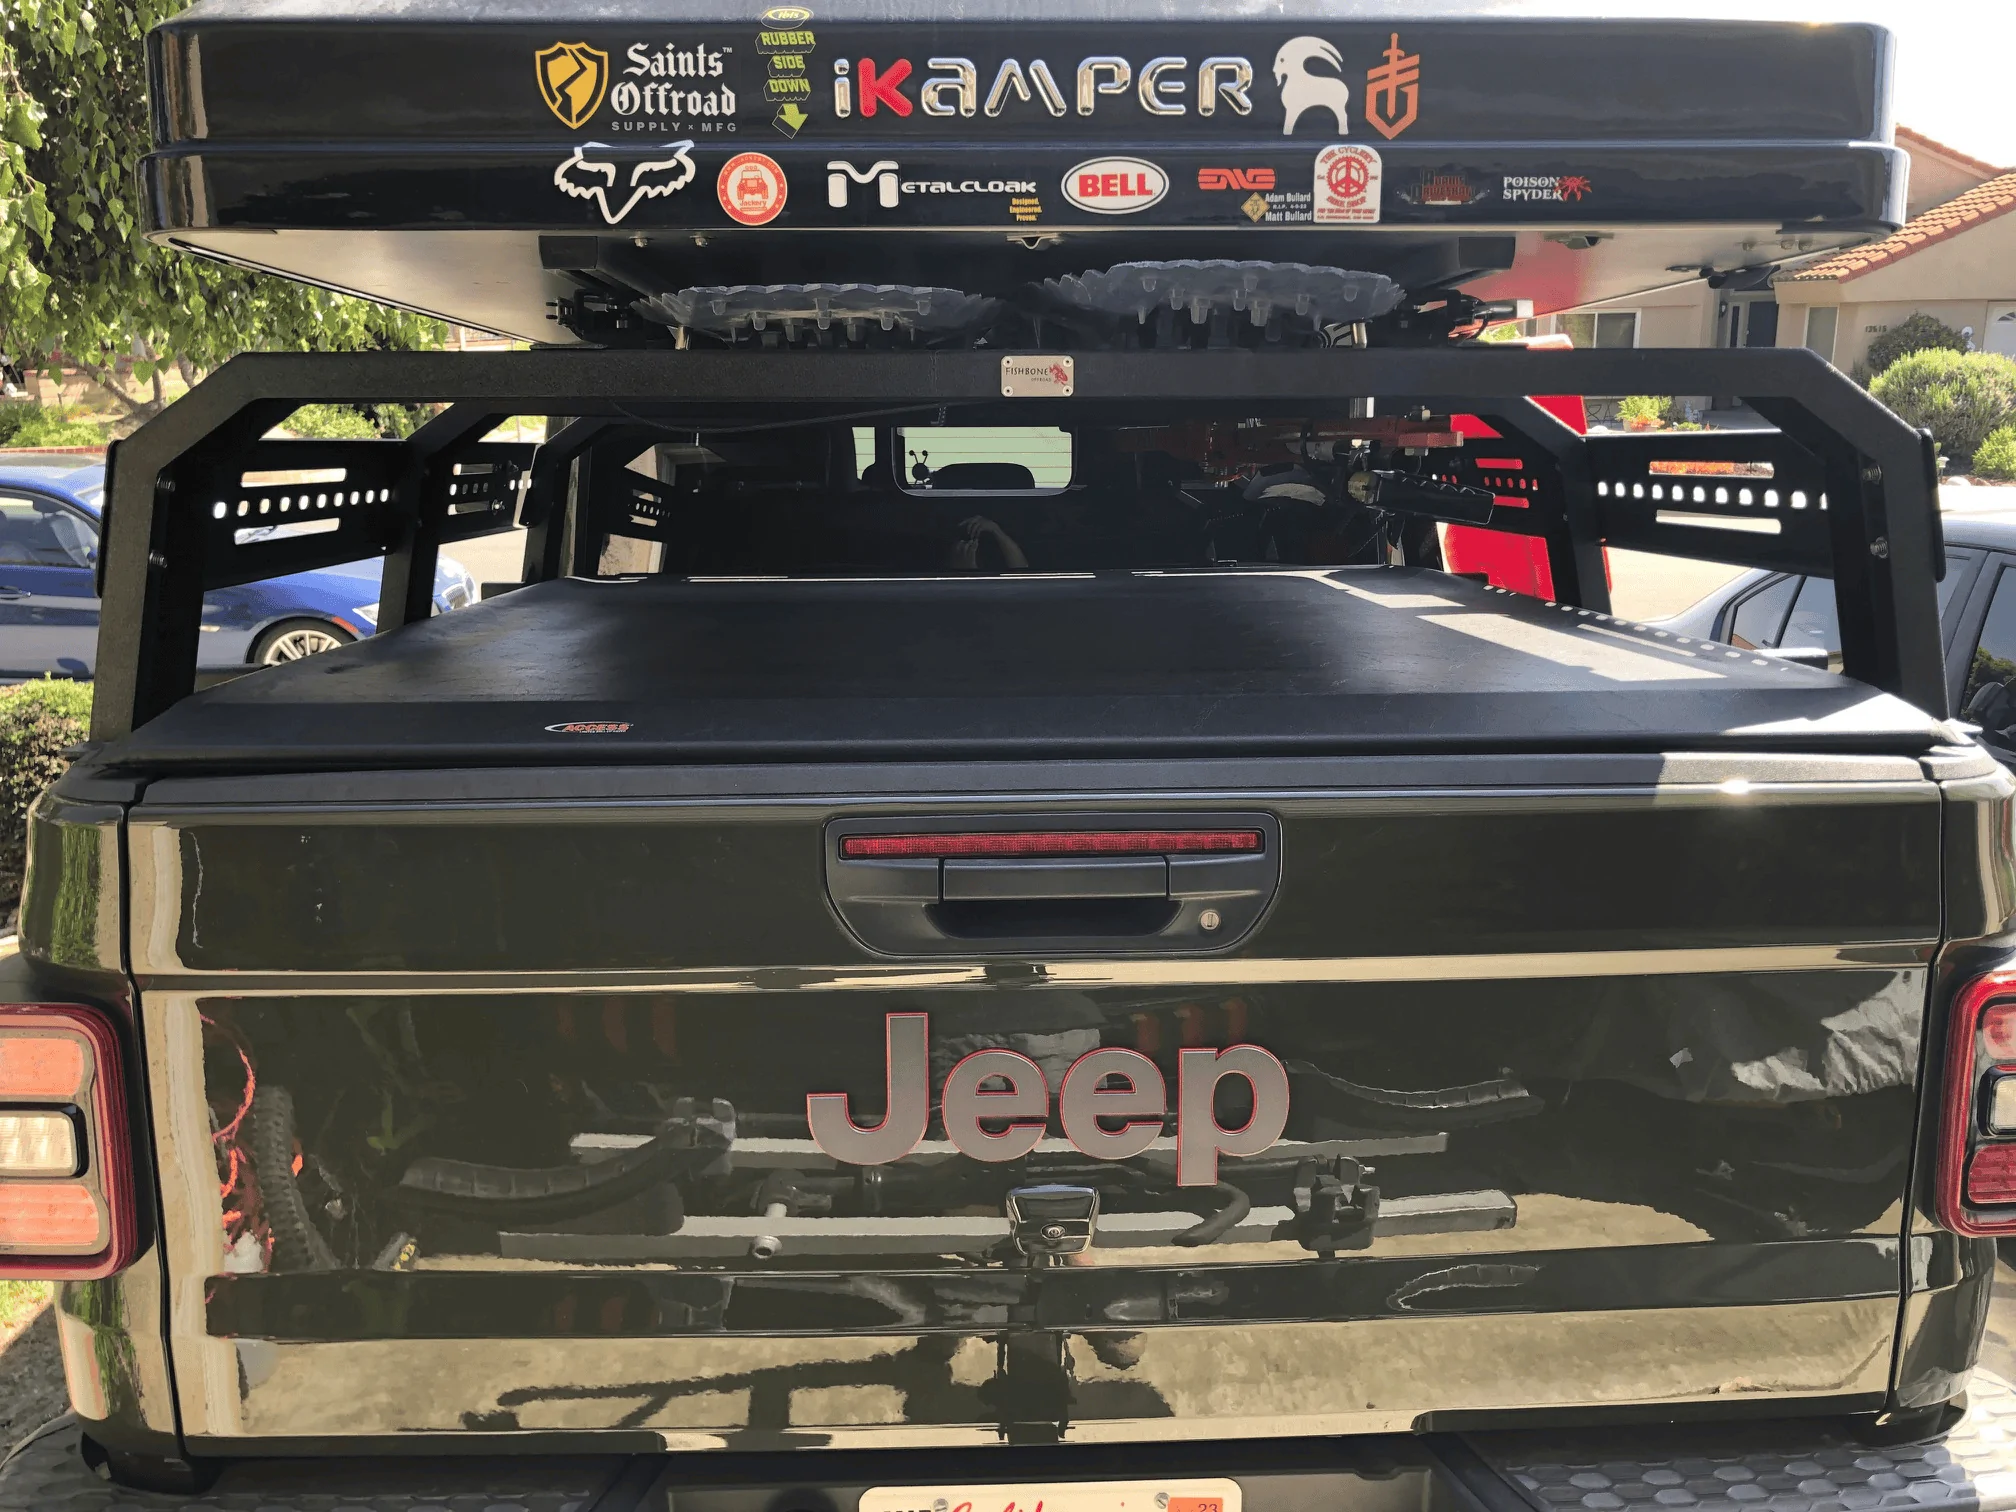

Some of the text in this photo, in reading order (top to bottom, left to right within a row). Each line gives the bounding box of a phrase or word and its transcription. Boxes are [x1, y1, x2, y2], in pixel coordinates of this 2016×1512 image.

[760, 31, 816, 46] RUBBER
[623, 41, 723, 77] Saints
[773, 54, 805, 69] SIDE
[768, 78, 811, 93] DOWN
[610, 81, 737, 116] Offroad
[611, 121, 681, 132] SUPPLY
[702, 122, 737, 132] MFG
[1078, 172, 1154, 198] BELL
[1503, 176, 1561, 188] POISON
[1265, 192, 1311, 202] Adam Bullard
[1502, 189, 1564, 201] SPYDER
[1265, 211, 1312, 221] Matt Bullard
[1005, 367, 1048, 376] FISHBONE
[806, 1012, 1290, 1187] Jeep
